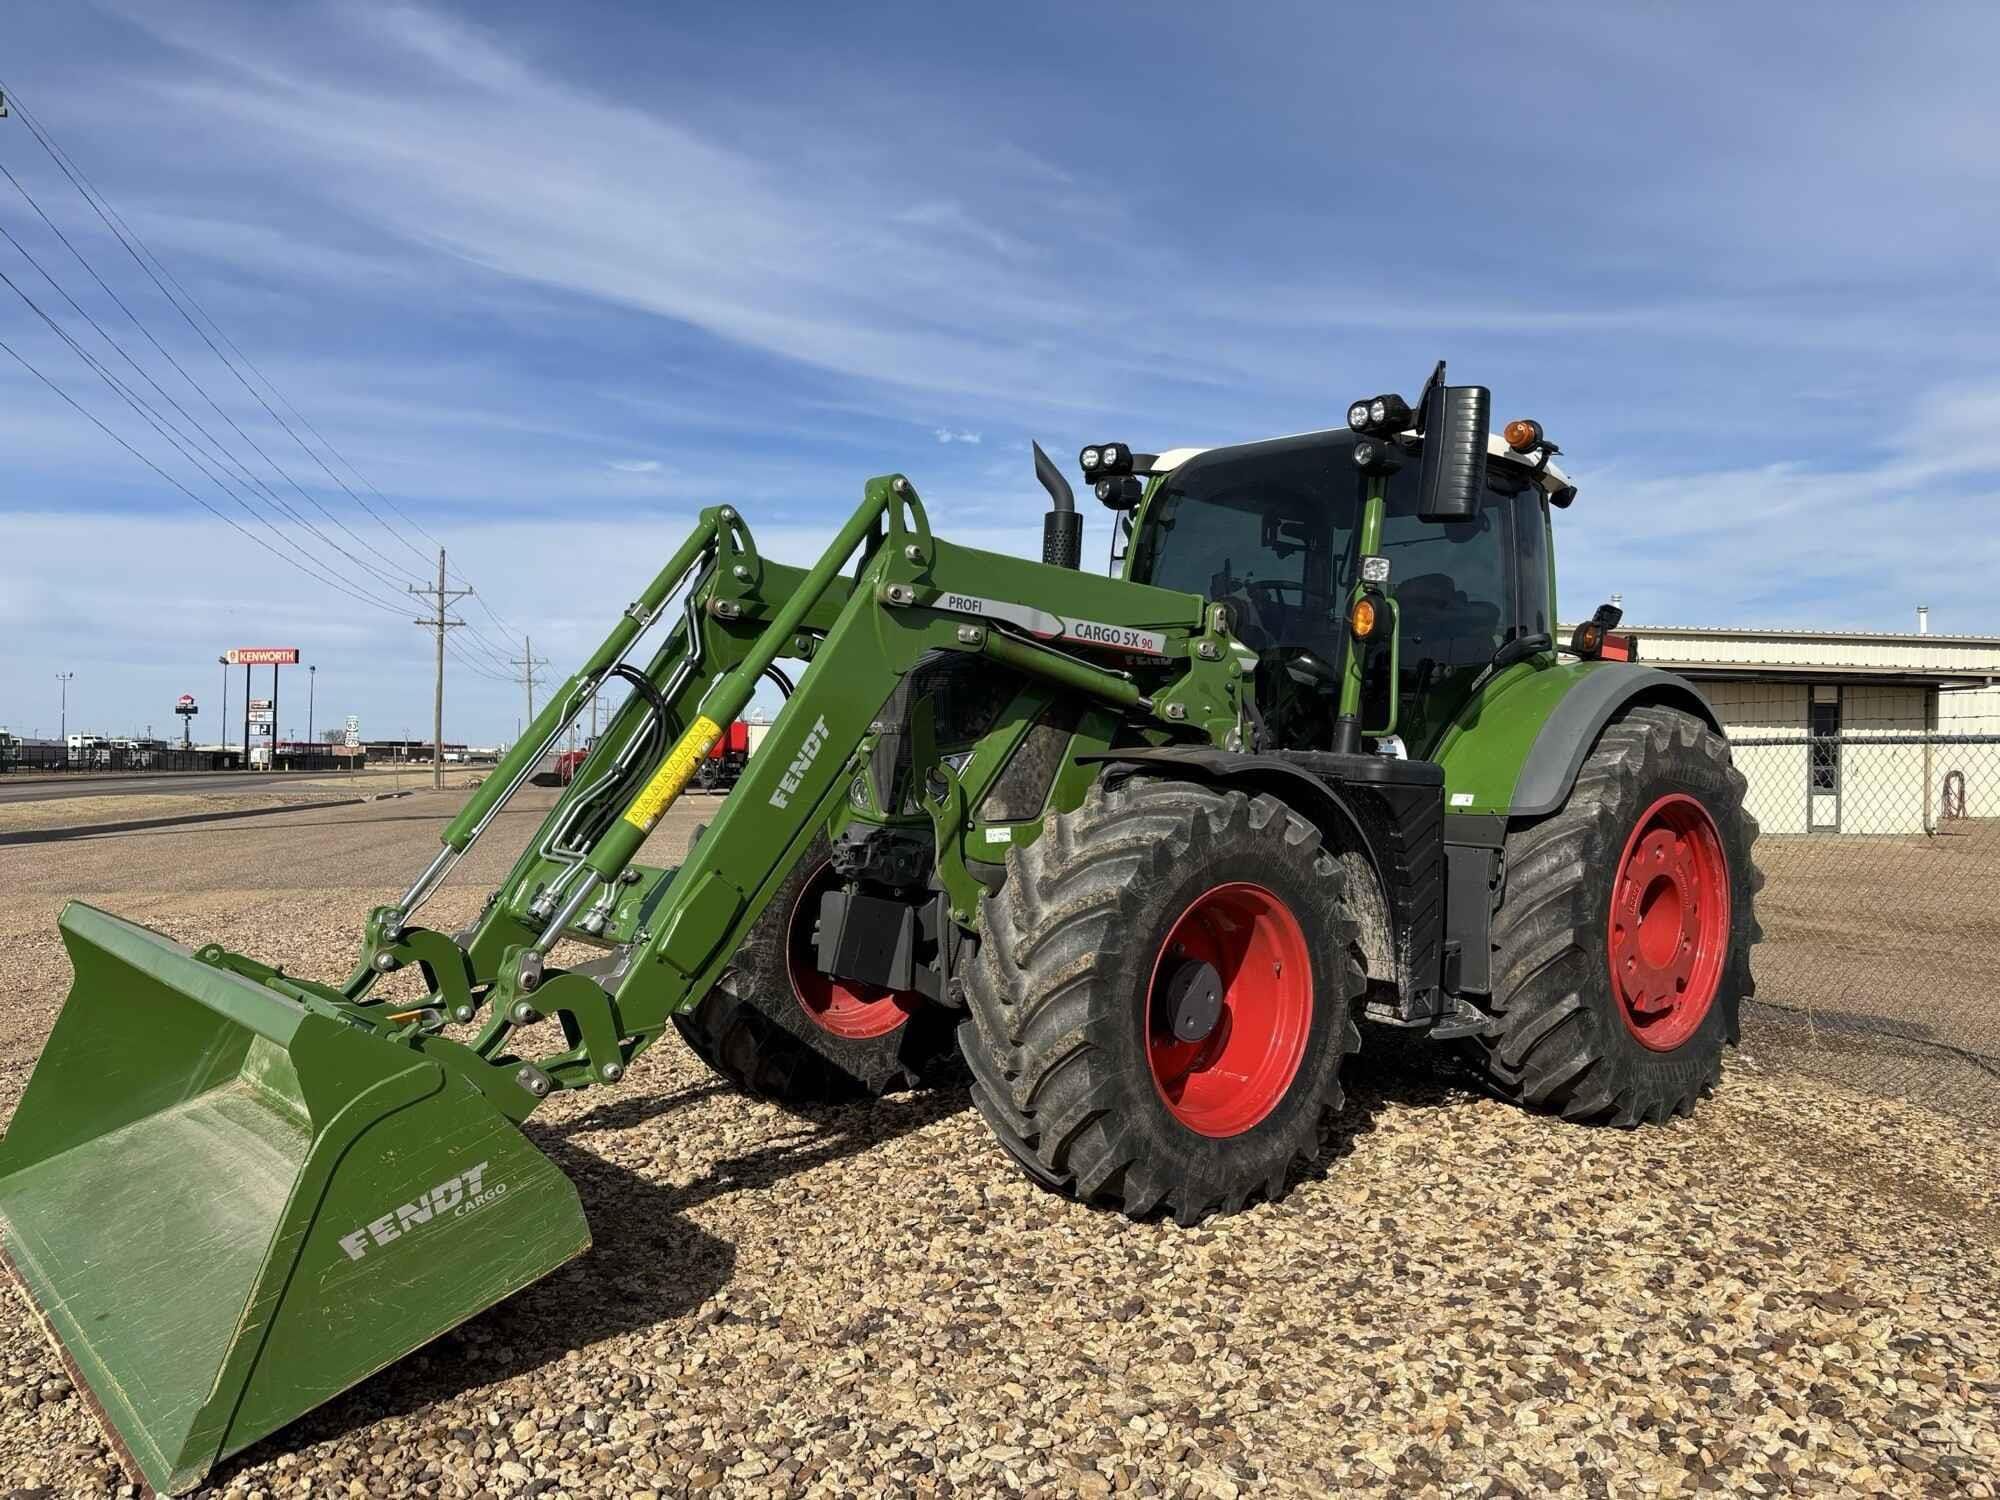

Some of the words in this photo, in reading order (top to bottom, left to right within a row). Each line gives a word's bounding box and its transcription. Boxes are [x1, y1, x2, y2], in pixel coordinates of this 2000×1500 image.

[948, 595, 982, 613] PROFI
[1074, 623, 1121, 644] CARGO
[1122, 631, 1140, 648] 5X
[1141, 638, 1153, 650] 90
[240, 651, 294, 662] KENWORTH
[768, 713, 829, 809] FENDT
[338, 1160, 488, 1261] FENDT
[454, 1183, 507, 1217] CARGO
